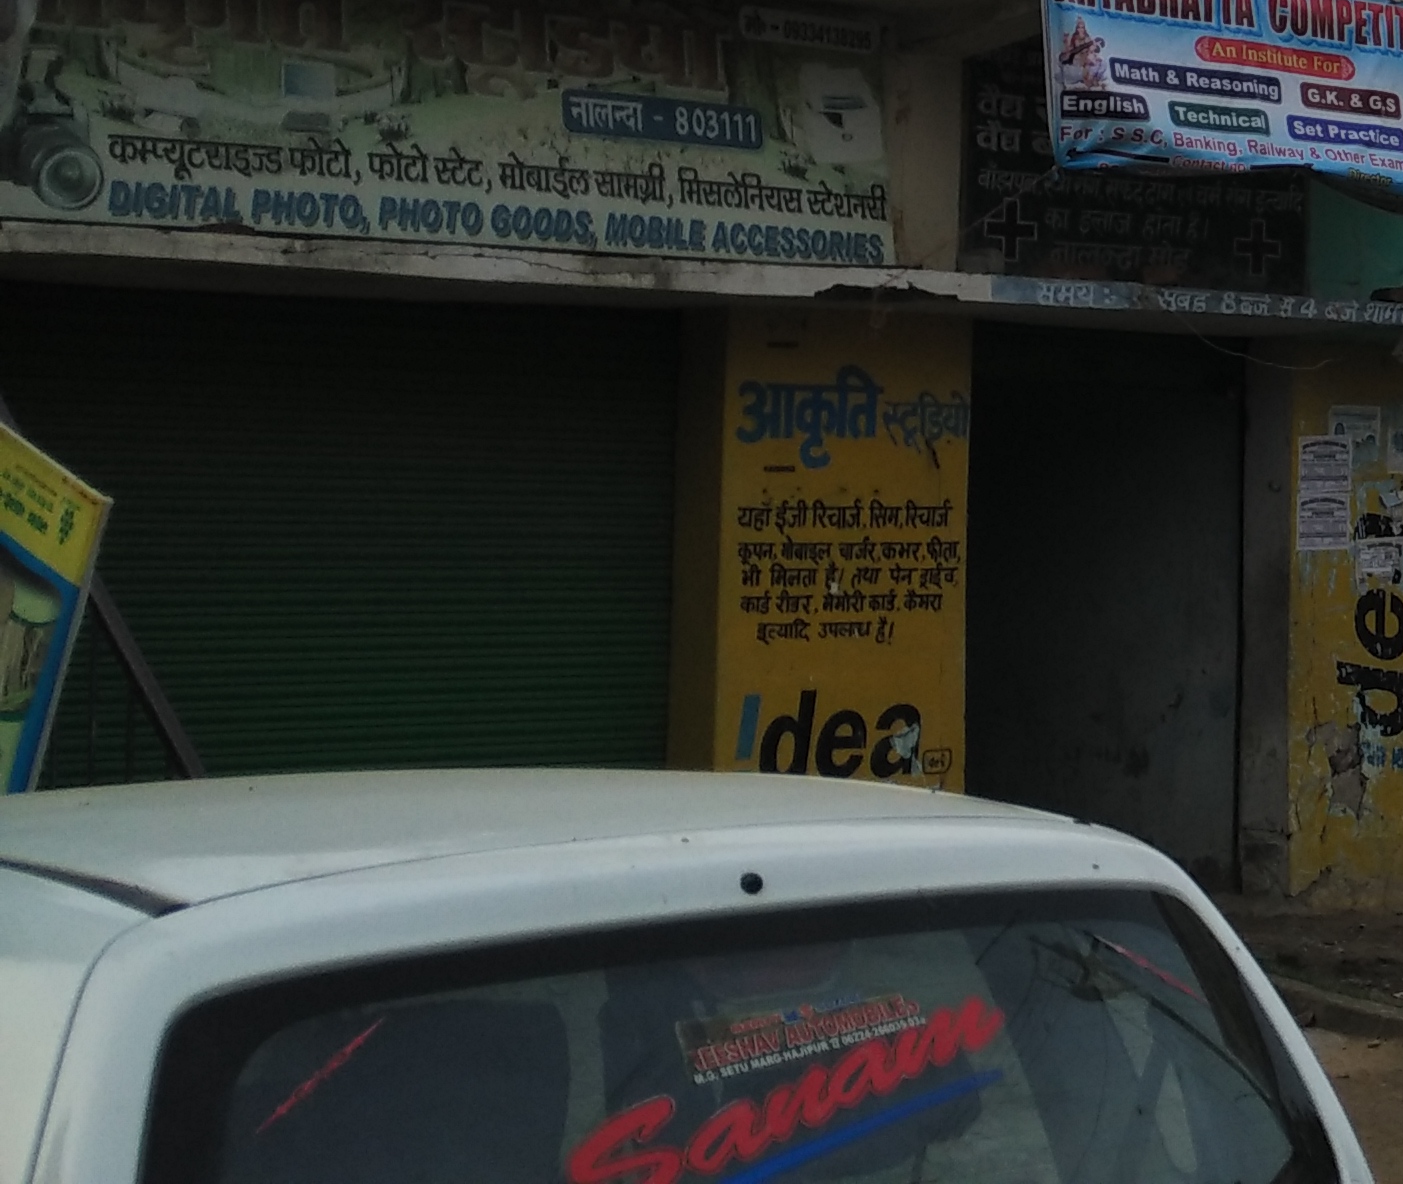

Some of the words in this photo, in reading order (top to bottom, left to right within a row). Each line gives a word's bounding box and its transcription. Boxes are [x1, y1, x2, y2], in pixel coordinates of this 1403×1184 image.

[1211, 42, 1237, 60] An
[1242, 44, 1308, 70] Institute
[1313, 56, 1340, 74] For
[1114, 62, 1160, 83] Math
[1166, 69, 1180, 85] &
[1186, 75, 1279, 100] Reasoning
[568, 95, 644, 132] नालन्दा
[675, 106, 758, 143] 803111
[1062, 95, 1145, 115] English
[1174, 105, 1266, 129] Technical
[1174, 132, 1243, 156] Banking,
[1247, 139, 1305, 161] Railway
[1310, 147, 1321, 160] &
[1325, 149, 1365, 164] Other
[1293, 120, 1323, 137] Set
[1329, 126, 1400, 147] Practice
[367, 142, 428, 184] फोटो
[109, 181, 241, 221] DIGITAL
[252, 189, 371, 234] PHOTO,
[378, 196, 484, 236] PHOTO
[490, 204, 597, 250] GOODS,
[604, 212, 706, 251] MOBILE
[711, 222, 885, 265] ACCESSORIES
[736, 364, 884, 469] आकृति
[775, 500, 807, 535] ईजी
[770, 563, 818, 587] मिलता
